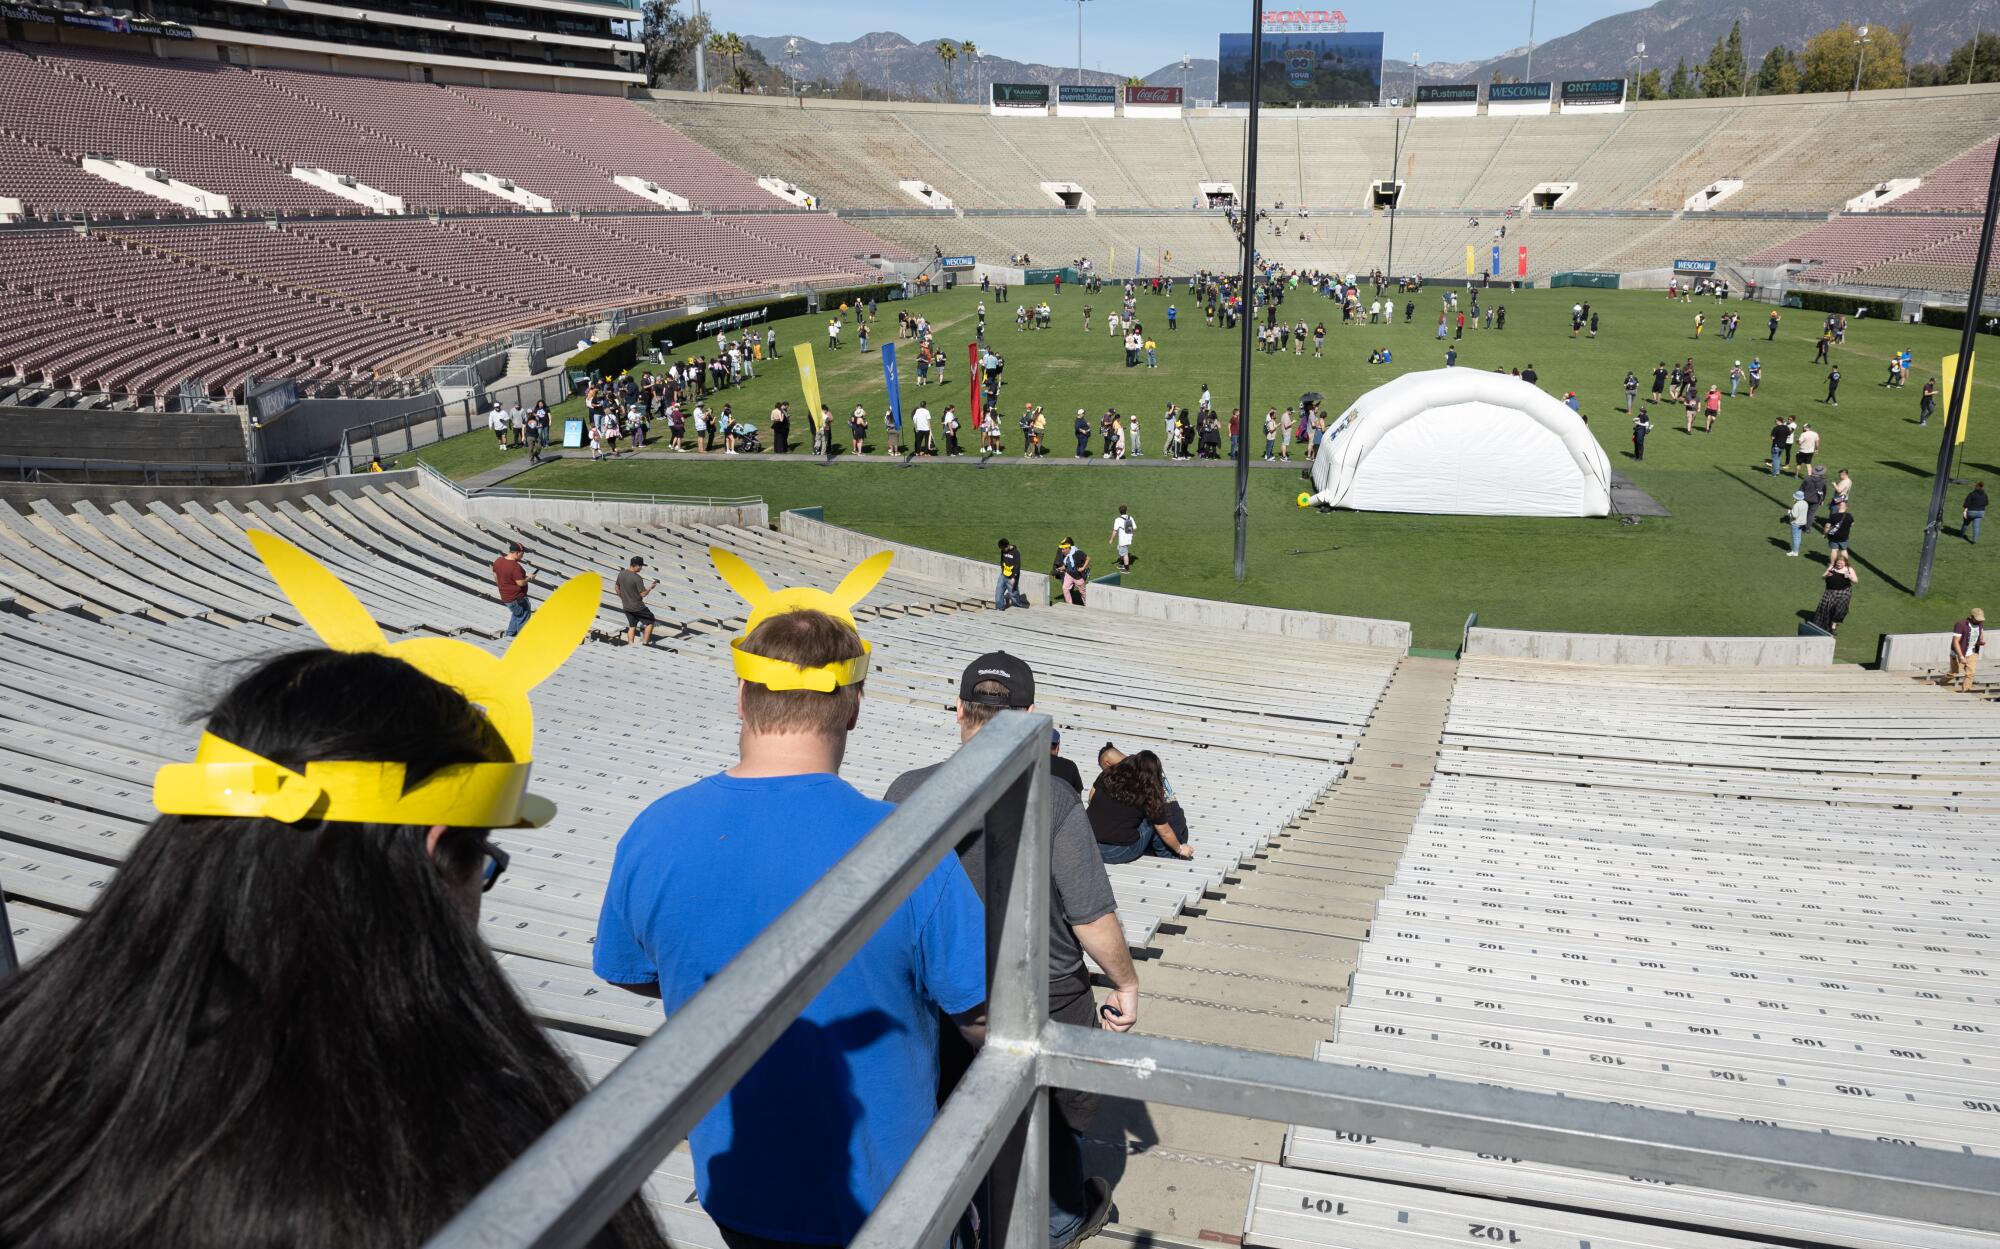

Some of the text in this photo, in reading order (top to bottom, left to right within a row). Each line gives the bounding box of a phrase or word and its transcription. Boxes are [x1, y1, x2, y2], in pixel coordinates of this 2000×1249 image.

[1262, 10, 1347, 24] HONDA
[165, 28, 192, 39] LOUNGE
[1492, 86, 1537, 96] WESCOM
[1567, 81, 1618, 92] ONTARIO
[1060, 93, 1114, 101] events365.com
[1431, 89, 1475, 98] Postmates
[1678, 261, 1704, 270] WESCOM
[1477, 918, 1502, 926] 102
[1820, 982, 1849, 990] 106
[584, 988, 598, 996] 4
[1386, 955, 1412, 964] 101
[1467, 966, 1496, 974] 102
[1758, 1001, 1789, 1009] 105
[1851, 1012, 1883, 1021] 106
[1953, 1024, 1984, 1032] 107
[1386, 990, 1926, 1059] 101 102 103 104 105 106
[1375, 1025, 1406, 1035] 101
[1480, 1040, 1513, 1050] 102
[1590, 1054, 1625, 1065] 103
[1710, 1070, 1747, 1081] 104
[1835, 1086, 1875, 1097] 105
[1302, 1197, 1521, 1243] 101 102
